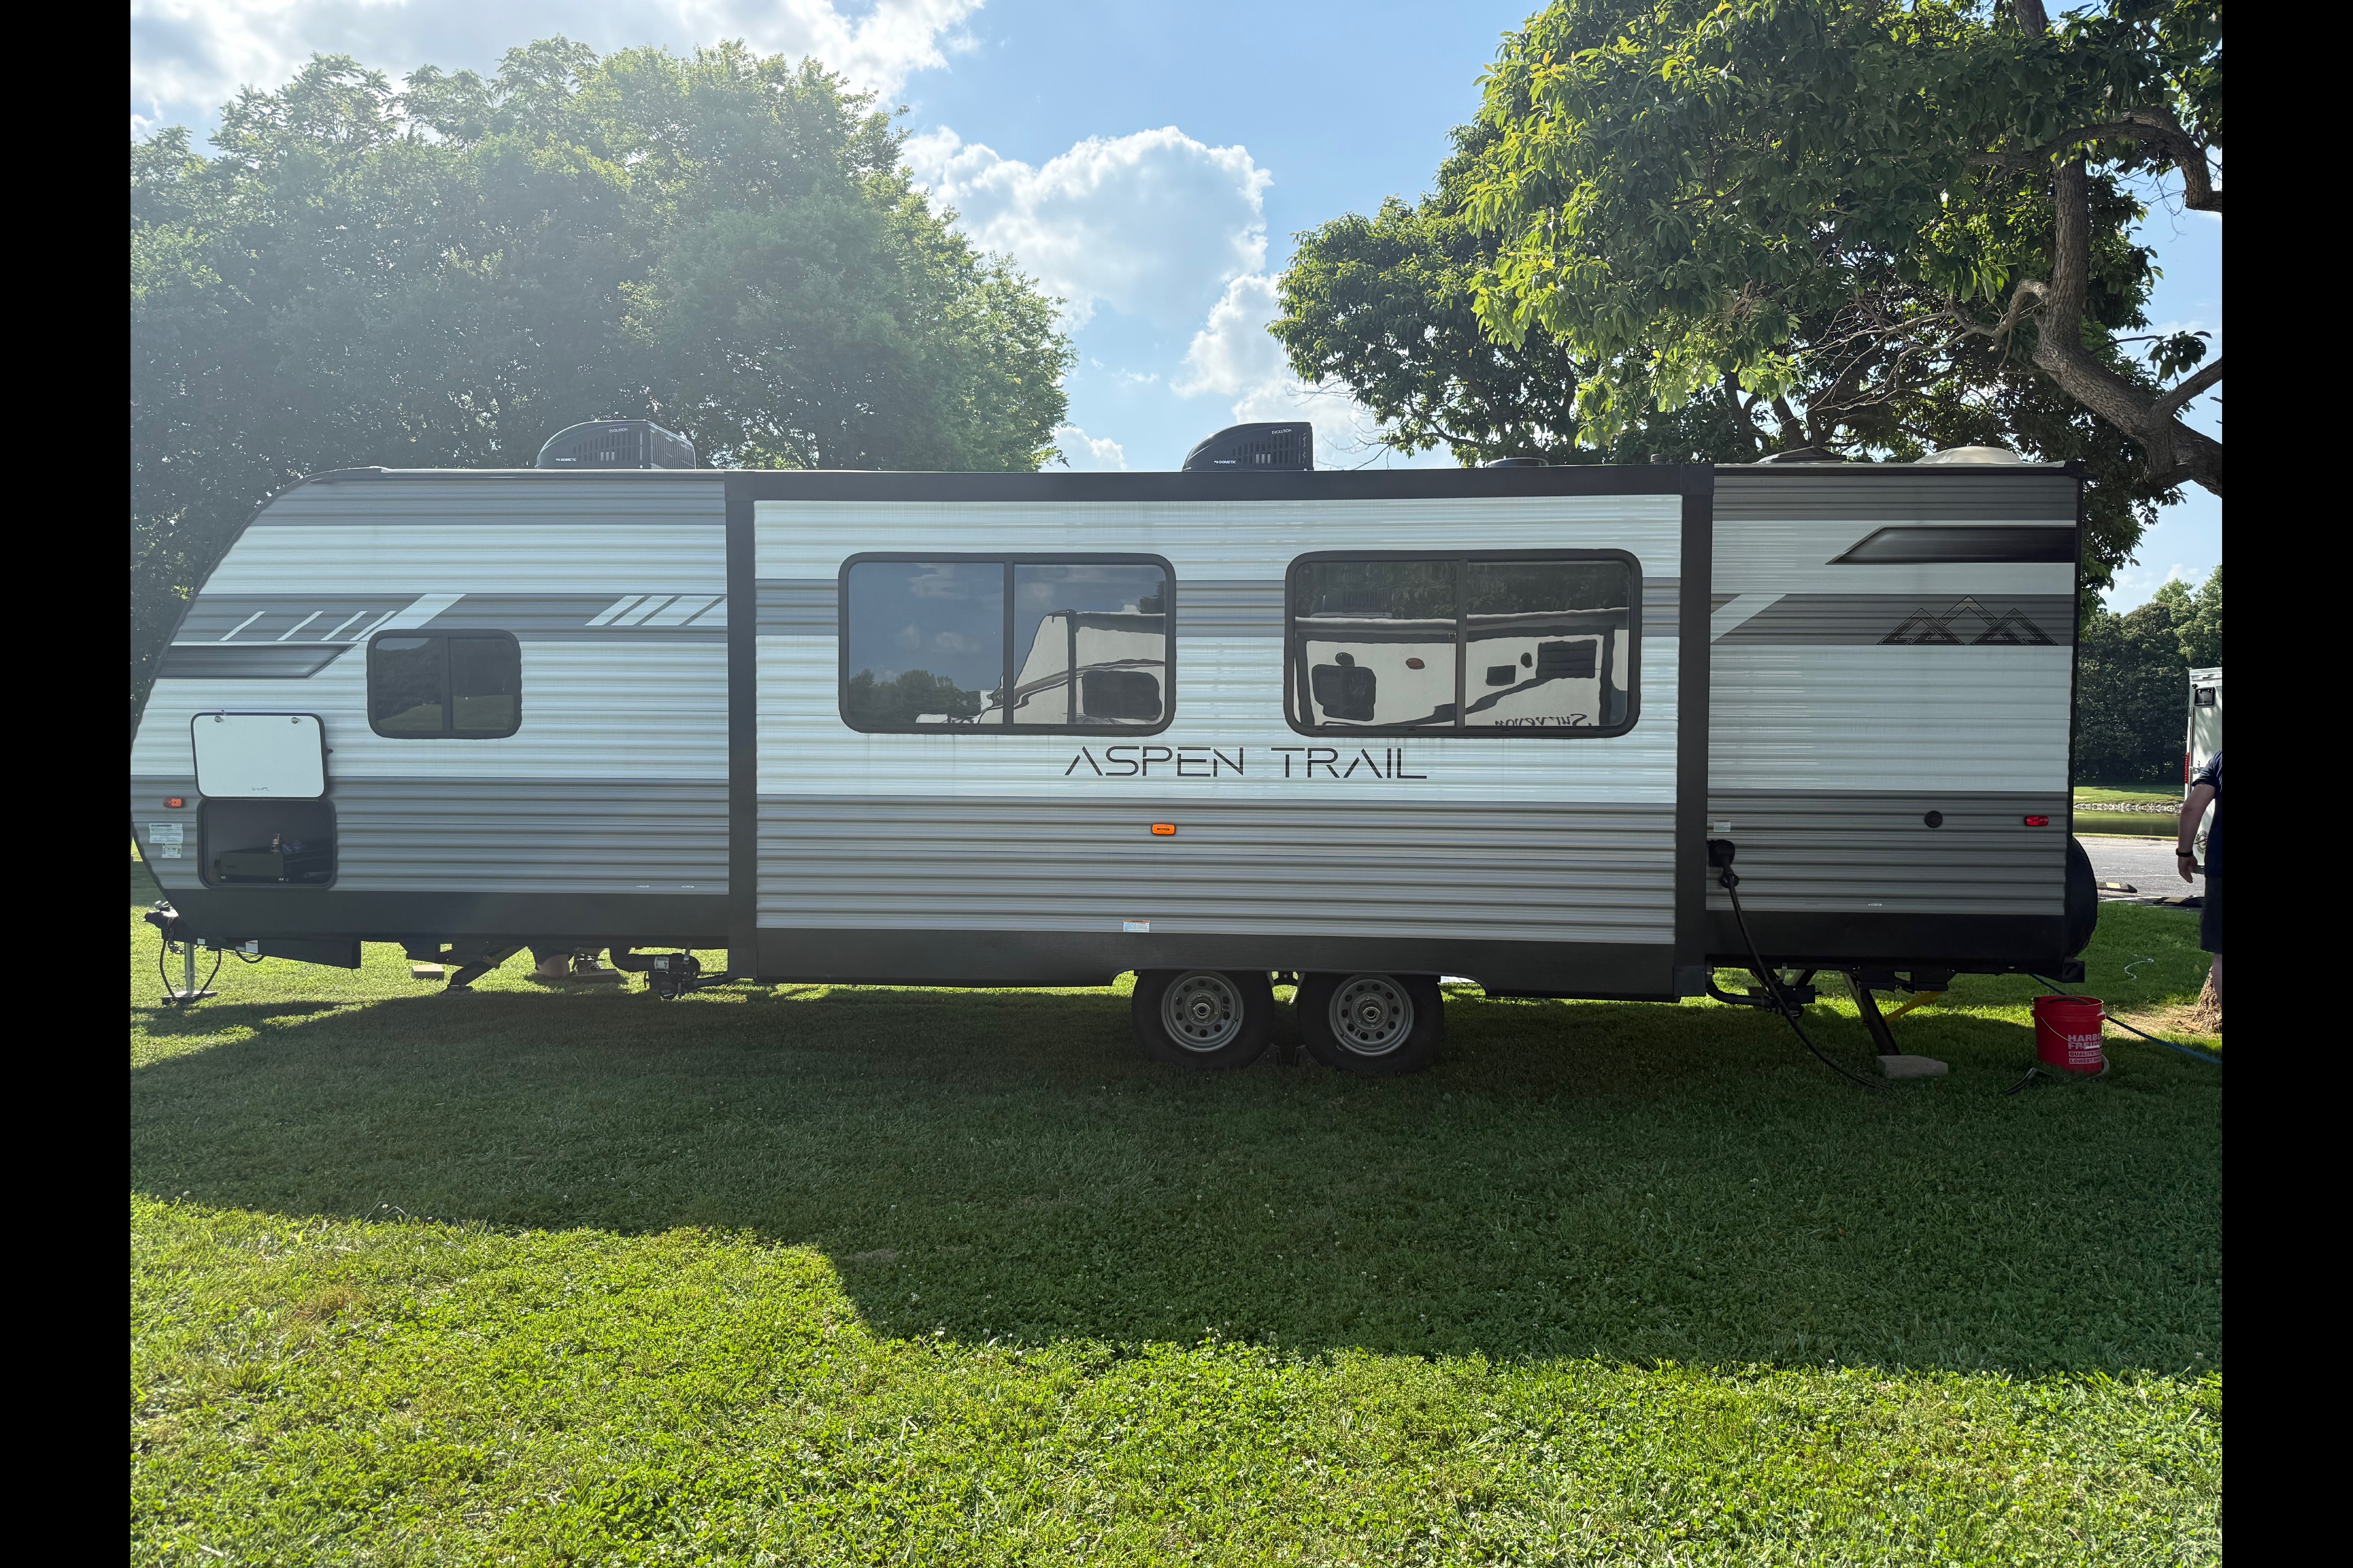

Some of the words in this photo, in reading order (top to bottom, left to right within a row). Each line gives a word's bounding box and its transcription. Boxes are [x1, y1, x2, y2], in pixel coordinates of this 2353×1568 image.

[1065, 746, 1244, 777] ASPEN
[1271, 747, 1427, 779] TRAIL
[2068, 1033, 2101, 1042] HARBO
